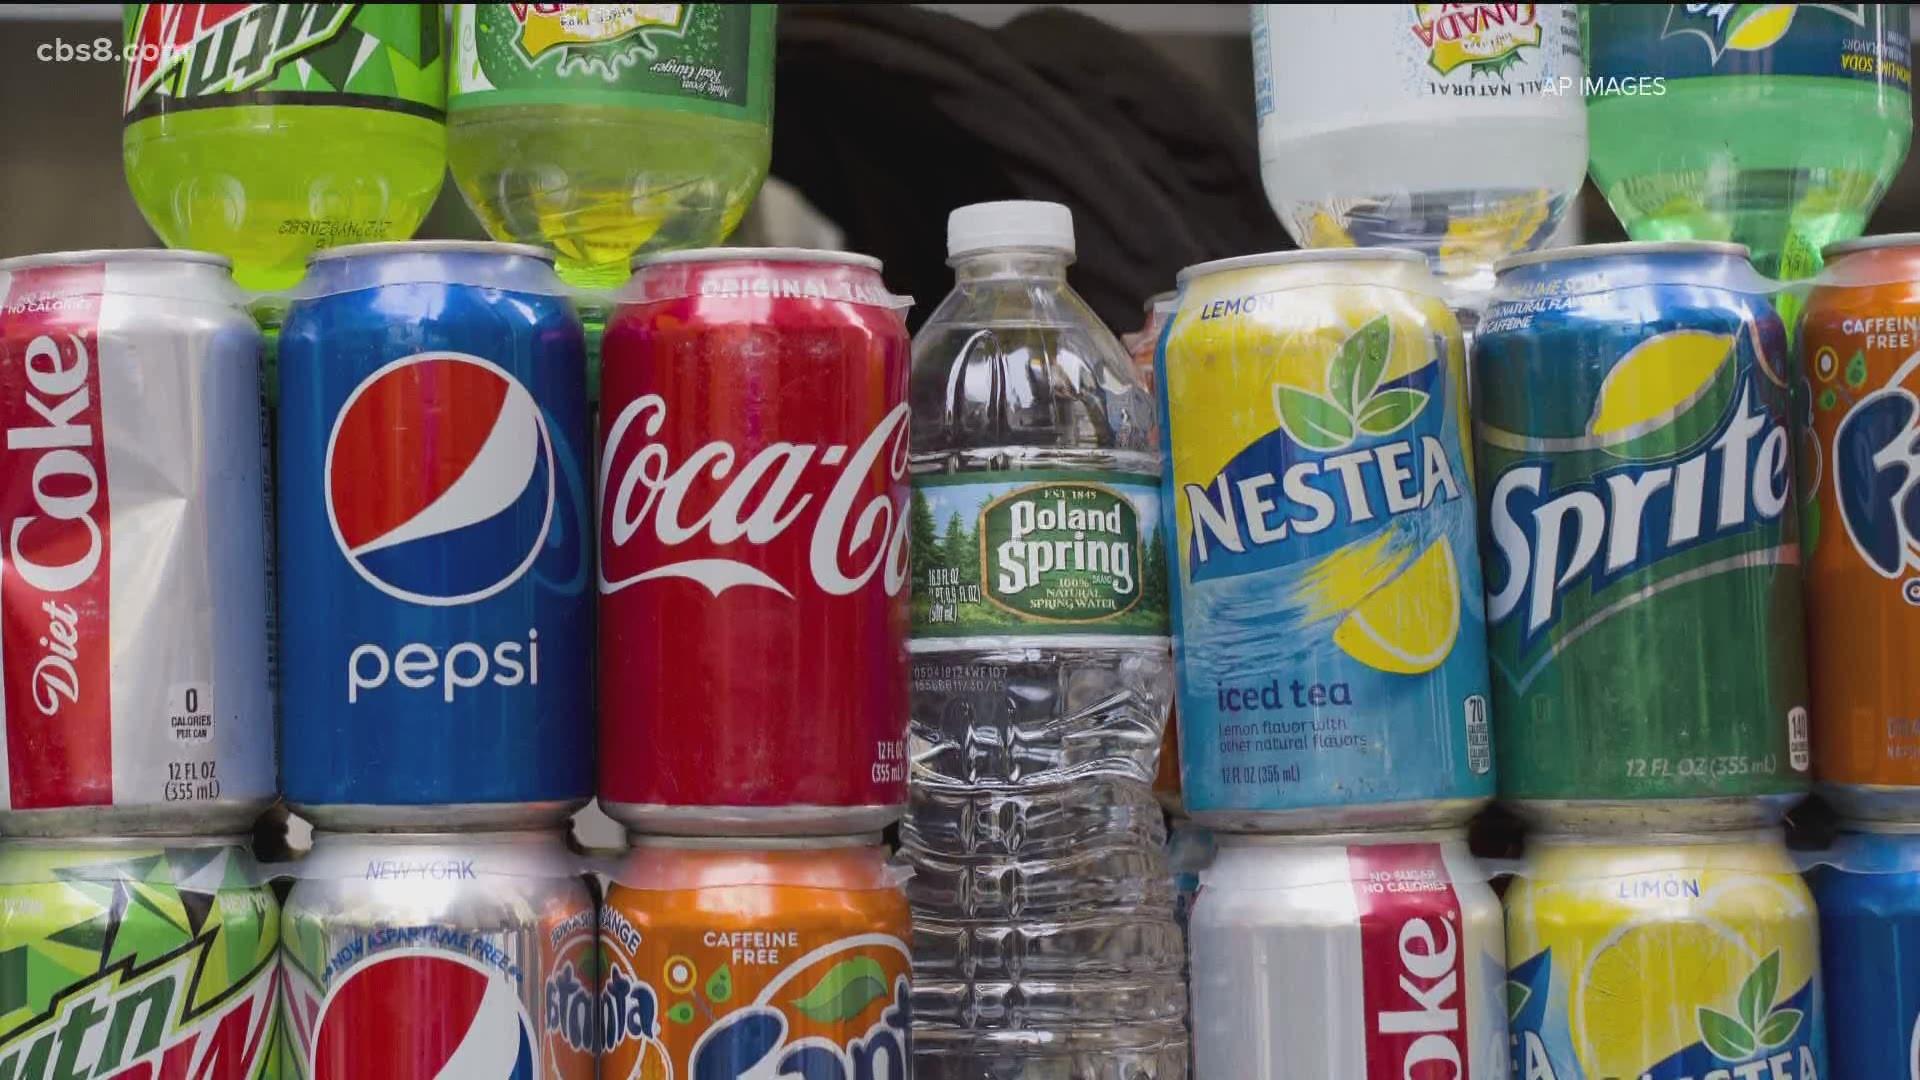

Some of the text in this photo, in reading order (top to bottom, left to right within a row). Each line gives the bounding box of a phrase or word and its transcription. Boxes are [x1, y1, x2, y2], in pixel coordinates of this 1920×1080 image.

[1841, 54, 1873, 72] SODA
[1429, 82, 1512, 97] NATURAL
[701, 278, 827, 299] ORIGINAL
[8, 303, 25, 315] NO
[1200, 296, 1274, 321] LEMON
[1842, 316, 1920, 335] CAFFEIN
[1866, 333, 1909, 350] FREE
[1184, 436, 1461, 564] NESTEA
[1487, 376, 1790, 638] Sprite
[8, 331, 102, 716] Diet Coke
[1010, 500, 1122, 539] Poland
[998, 530, 1134, 594] Spring
[950, 567, 960, 585] OZ
[1046, 587, 1101, 599] NATURAL
[1030, 598, 1118, 611] SPRING WATER
[348, 628, 537, 703] pepsi
[185, 688, 198, 713] 0
[1217, 679, 1352, 713] iced tea
[1470, 699, 1483, 722] 70
[171, 715, 212, 728] CALORIES
[1218, 719, 1346, 737] lemon flavor with
[192, 728, 207, 739] CAN
[878, 741, 886, 760] 12
[1220, 734, 1367, 753] other natural flavors
[168, 761, 216, 780] 12 FL OZ
[872, 763, 890, 783] (355
[1626, 759, 1646, 778] 12
[1651, 758, 1672, 777] FL
[1678, 757, 1706, 777] OZ
[1710, 755, 1748, 777] (355
[1751, 754, 1777, 775] mL)
[1222, 767, 1231, 785] 12
[164, 780, 220, 801] (355 mL)
[366, 860, 477, 881] NEW YORK
[1369, 869, 1437, 882] NO SUGAR
[1363, 880, 1447, 894] NO CALORIES
[331, 925, 512, 972] NOW ASPARTAME FREE
[704, 931, 798, 948] CAFFEINE
[732, 949, 779, 965] FREE
[1378, 914, 1462, 1080] oke
